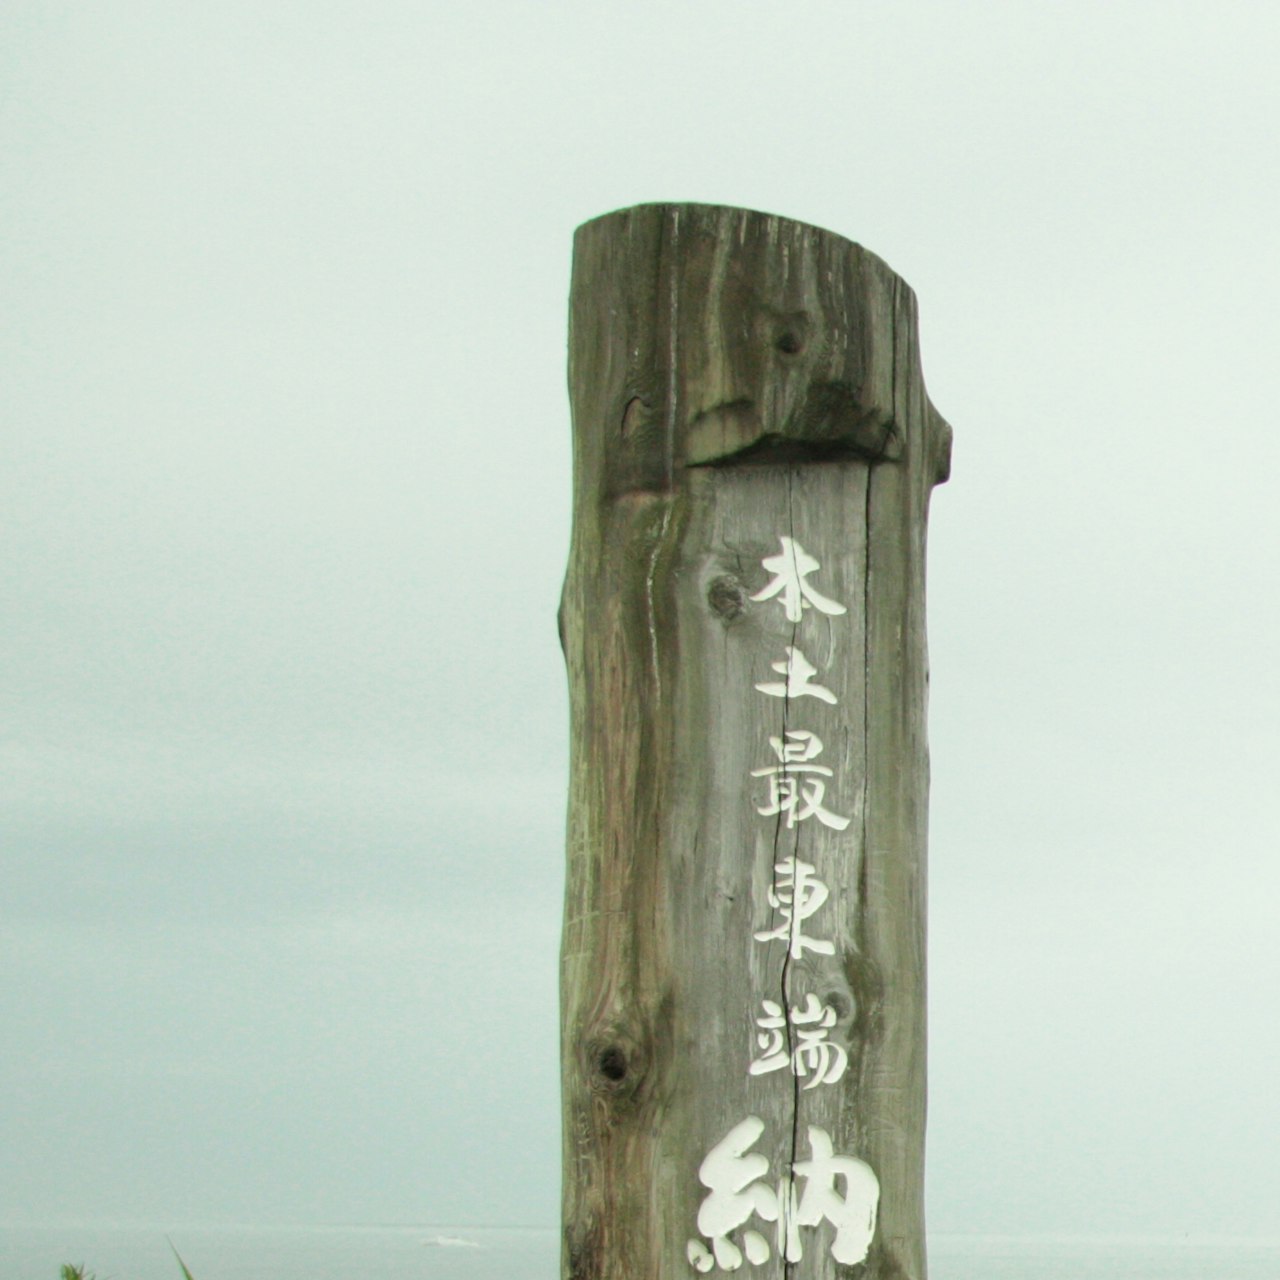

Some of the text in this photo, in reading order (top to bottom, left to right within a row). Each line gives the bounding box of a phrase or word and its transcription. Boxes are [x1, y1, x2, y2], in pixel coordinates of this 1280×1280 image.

[749, 535, 850, 1089] 本土最東端
